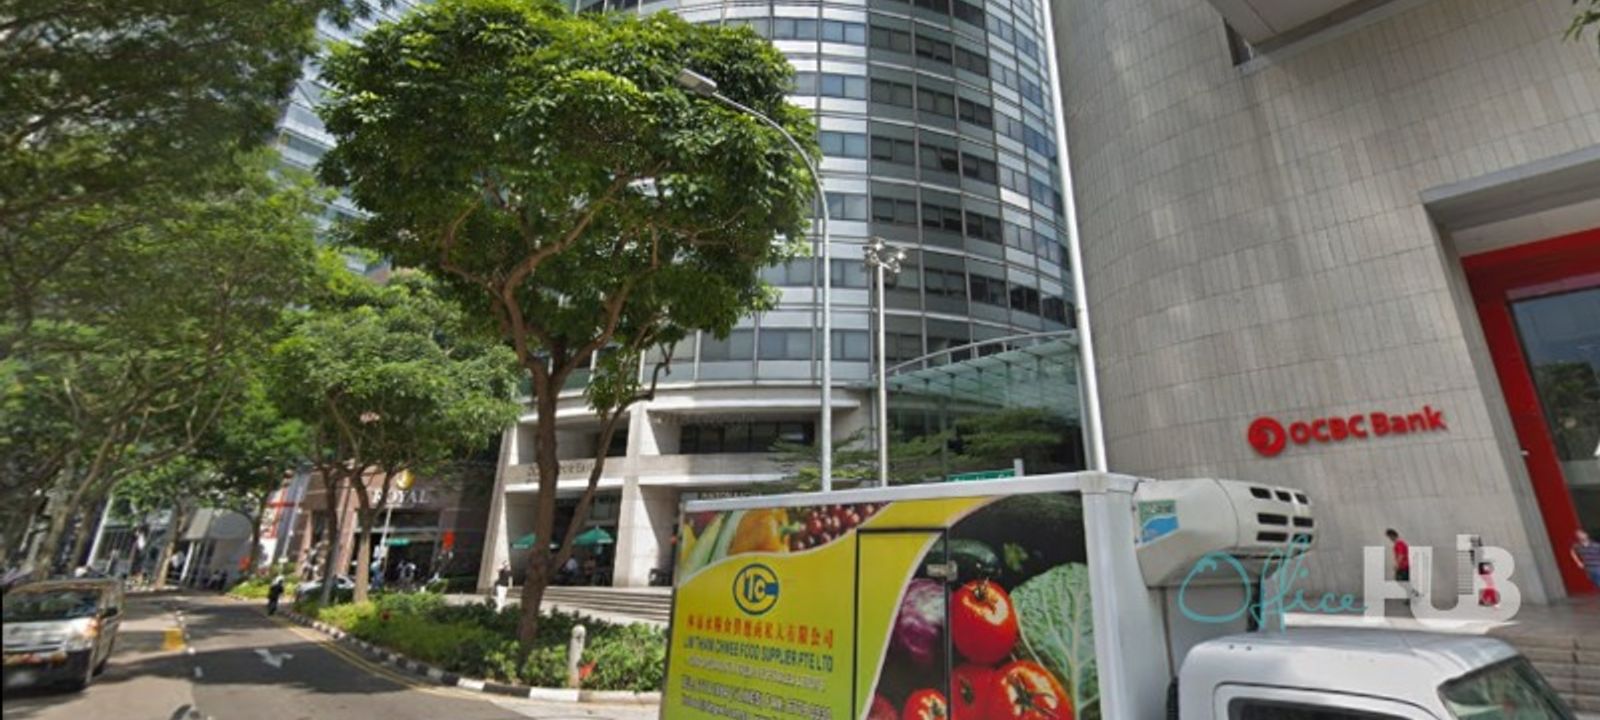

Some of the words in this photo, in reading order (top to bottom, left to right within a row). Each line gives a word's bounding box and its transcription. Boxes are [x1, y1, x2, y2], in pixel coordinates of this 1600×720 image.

[1289, 414, 1368, 446] OCBC
[1370, 405, 1448, 437] Bank
[740, 641, 760, 661] FOOD
[761, 644, 798, 667] SUPPLIER
[799, 650, 815, 669] PTE
[815, 652, 834, 673] LTD
